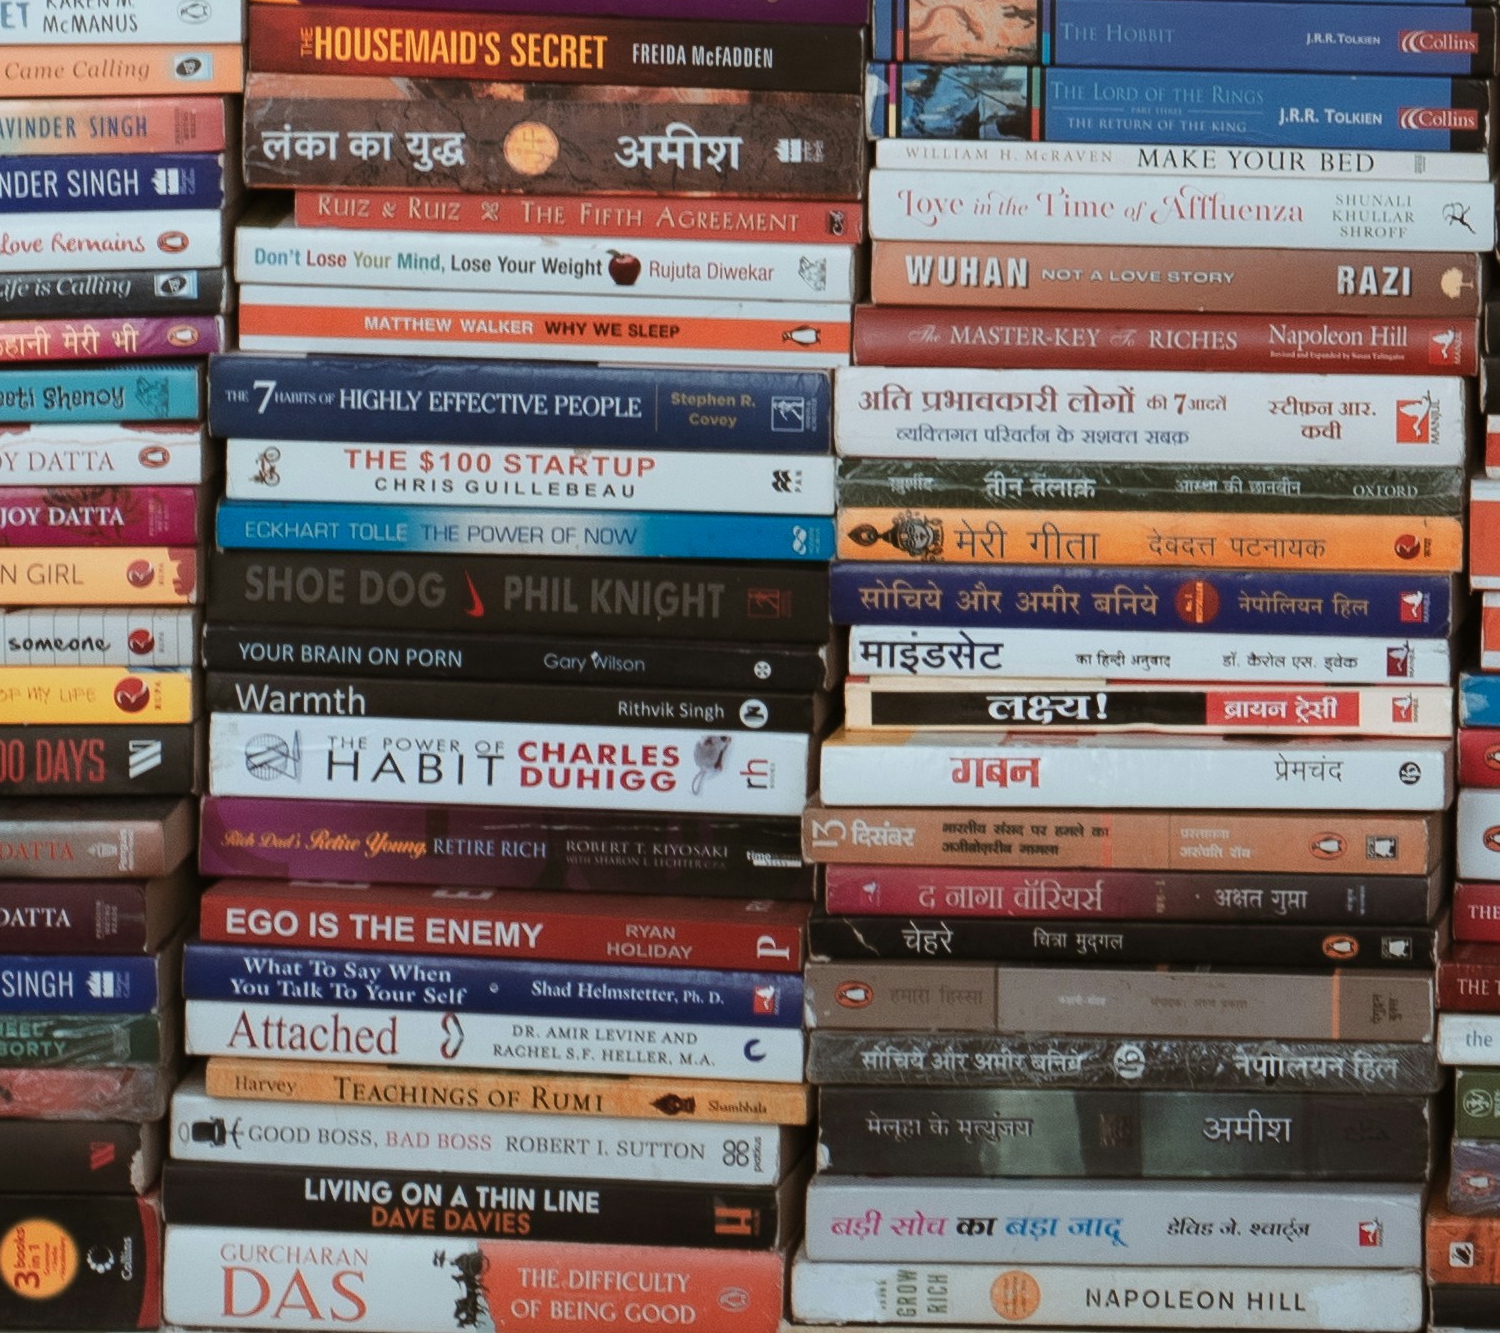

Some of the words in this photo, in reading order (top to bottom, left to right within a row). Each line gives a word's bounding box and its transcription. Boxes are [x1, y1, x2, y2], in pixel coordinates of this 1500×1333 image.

[649, 259, 702, 284] Rujuta
[708, 260, 774, 284] Diwekar
[954, 520, 1009, 562] मेरी
[1026, 525, 1102, 564] गीता
[1148, 530, 1217, 562] देवदत्त
[1230, 531, 1326, 562] पटनायक
[327, 748, 505, 786] HABIT
[518, 741, 681, 768] CHARLES
[521, 766, 679, 790] DUHIGG
[226, 1009, 399, 1058] Attached
